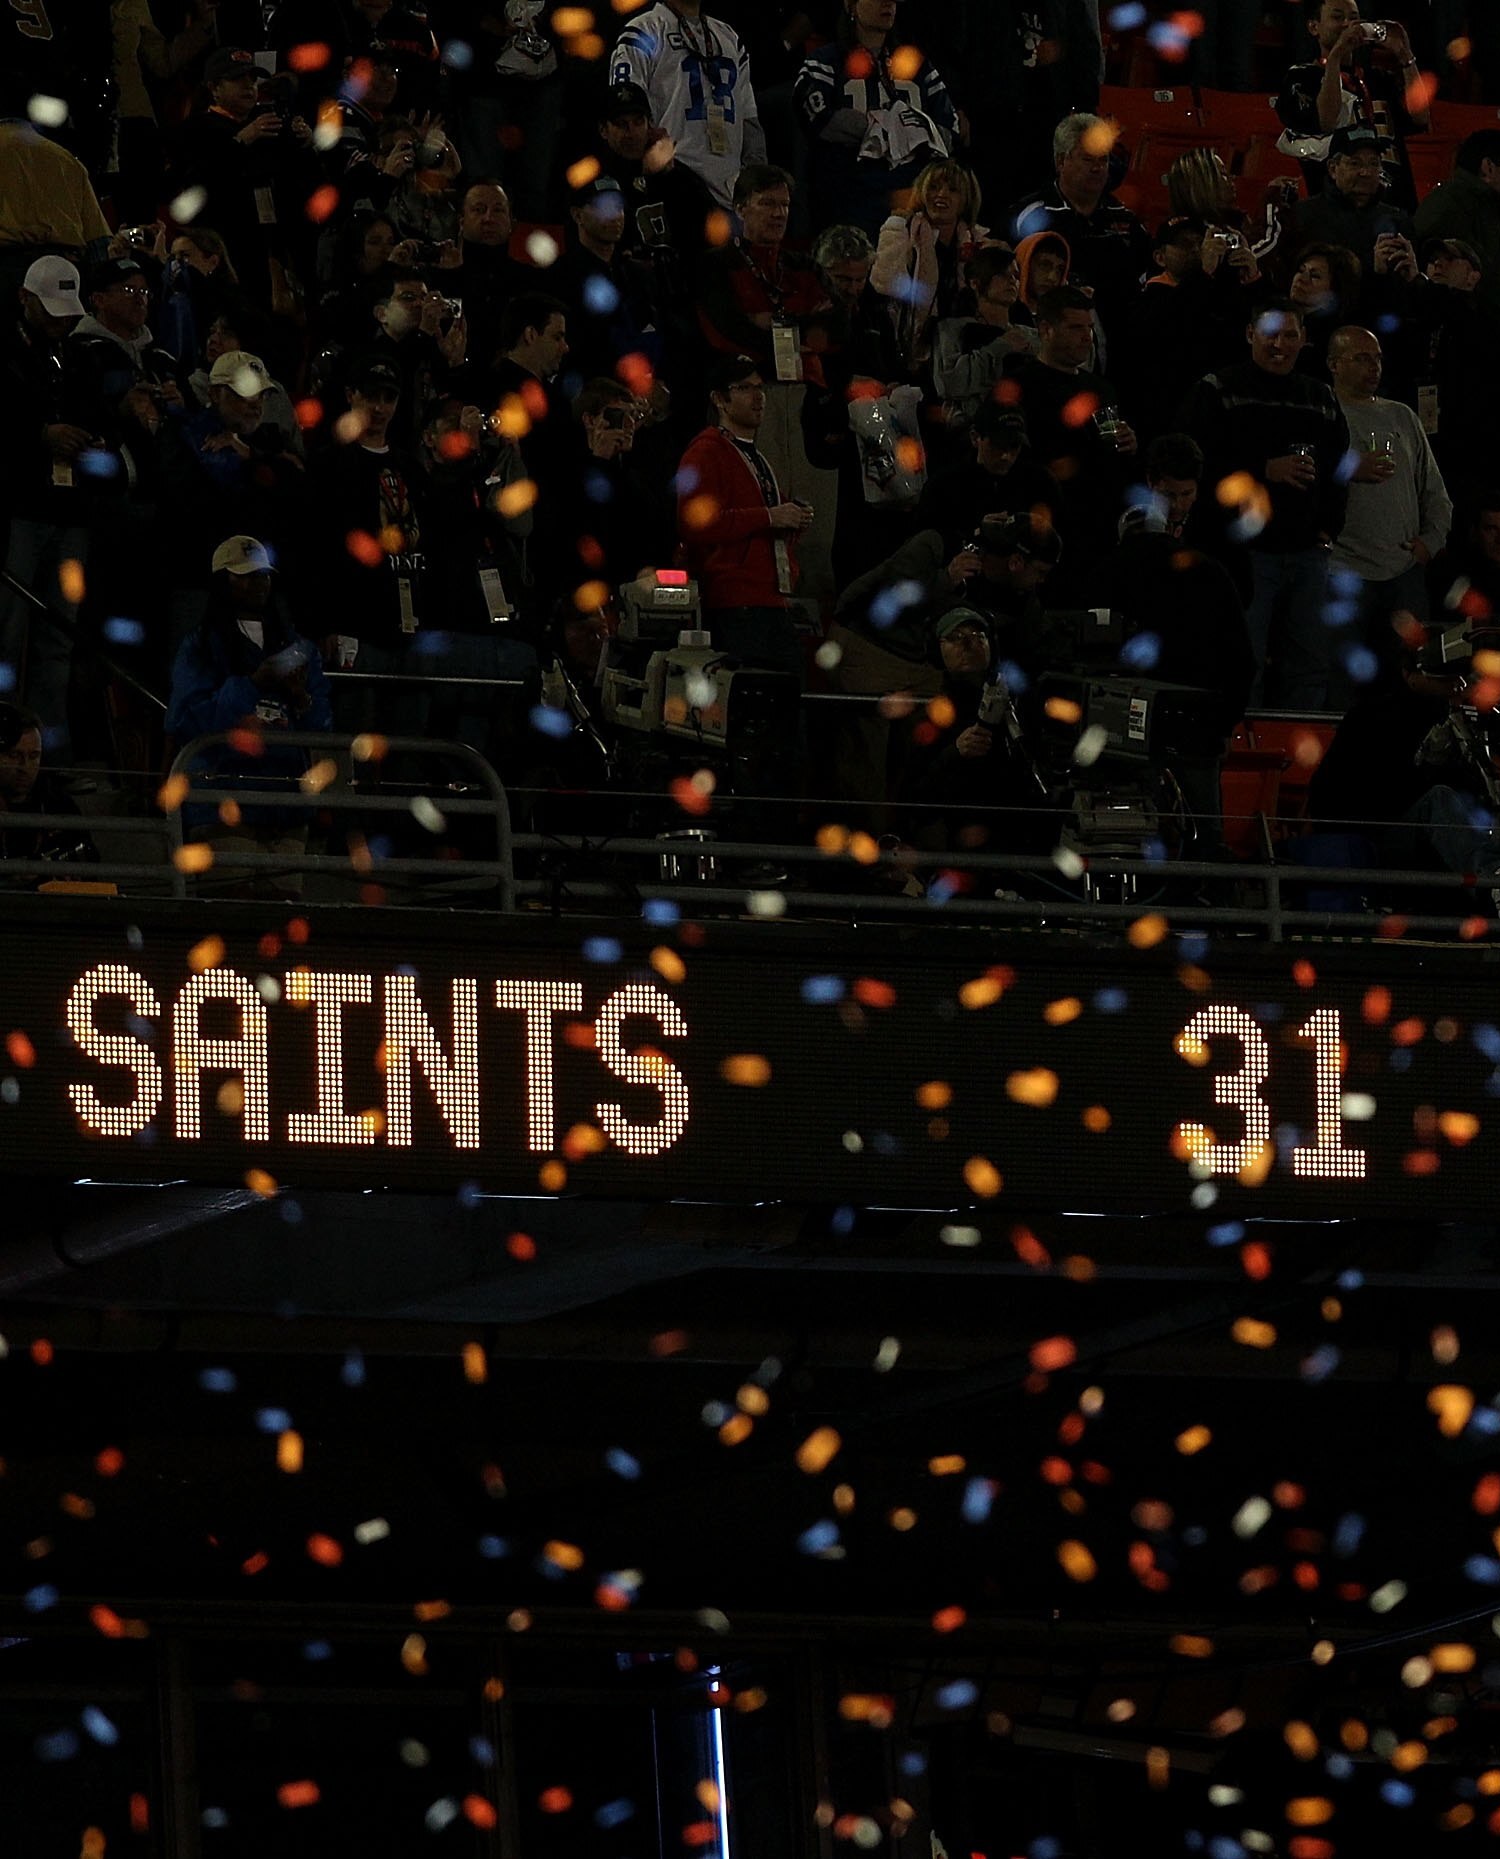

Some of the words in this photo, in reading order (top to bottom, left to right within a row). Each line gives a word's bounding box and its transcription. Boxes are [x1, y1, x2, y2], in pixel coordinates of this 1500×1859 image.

[682, 55, 737, 124] 18
[66, 962, 690, 1157] SAINTS
[1177, 1004, 1368, 1178] 31
